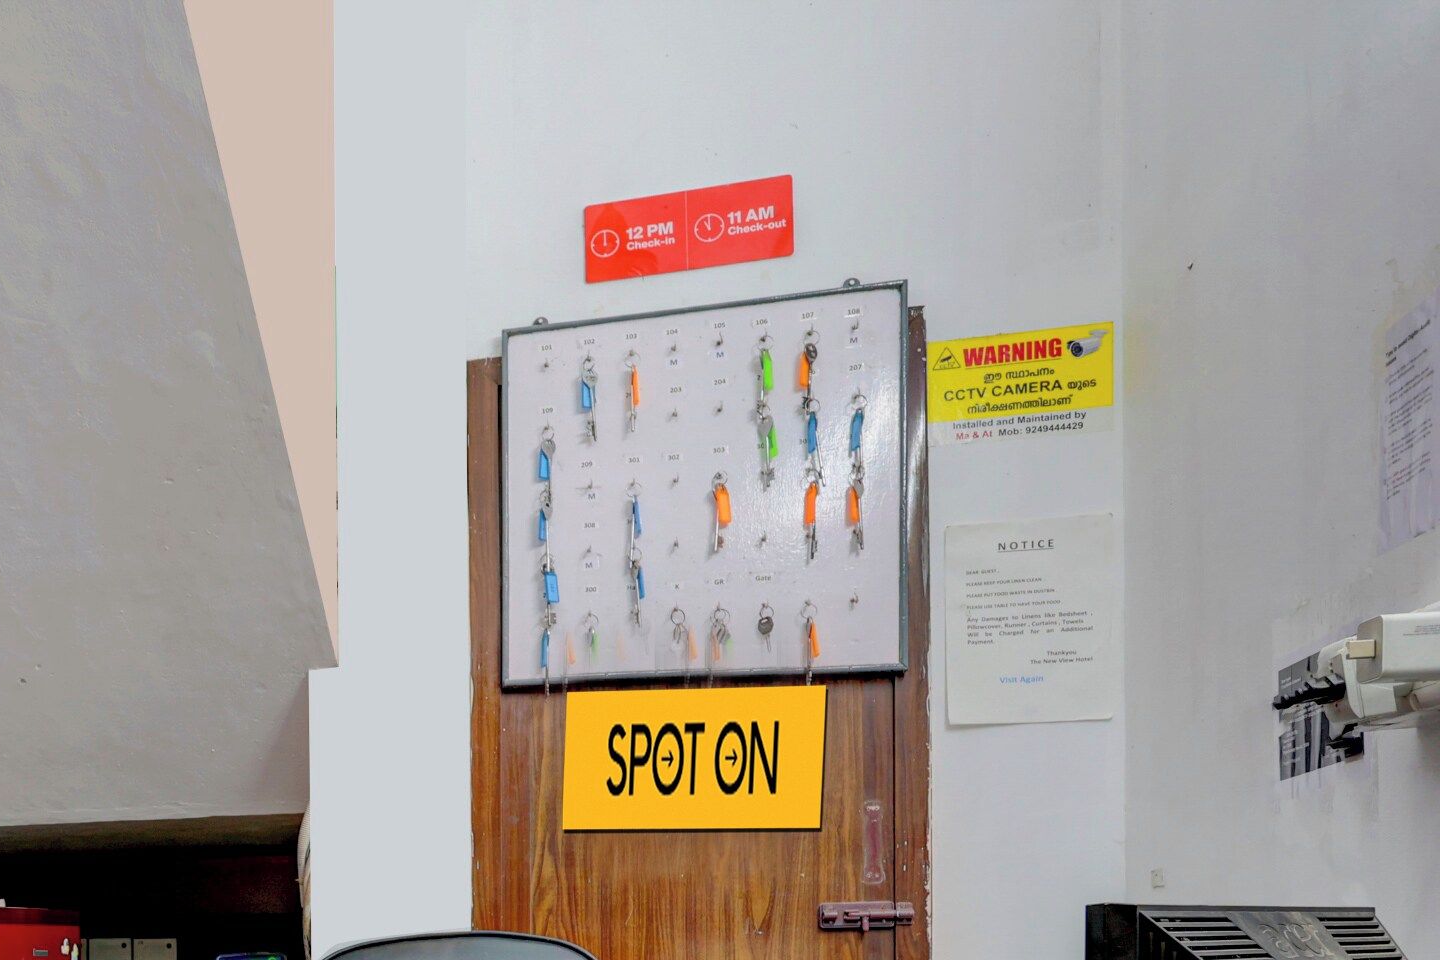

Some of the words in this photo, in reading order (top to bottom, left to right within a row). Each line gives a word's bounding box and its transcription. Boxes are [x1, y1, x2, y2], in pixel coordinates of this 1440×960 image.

[727, 211, 742, 225] 11
[745, 205, 775, 221] AM
[626, 226, 644, 240] 12
[647, 221, 674, 237] PM
[728, 218, 787, 236] Check-out
[626, 235, 676, 251] Check-in
[802, 312, 814, 320] 107
[848, 308, 861, 316] 108
[713, 322, 726, 330] 105
[755, 318, 768, 326] 106
[666, 328, 679, 336] 104
[963, 338, 1063, 367] WARNING
[849, 364, 862, 372] 207
[713, 378, 726, 386] 204
[944, 387, 986, 401] CCTV
[991, 379, 1063, 397] CAMERA
[953, 419, 994, 430] Installed
[996, 416, 1015, 427] and
[1017, 411, 1072, 425] Maintained
[1074, 410, 1087, 421] by
[998, 427, 1023, 437] Mob:
[1025, 422, 1084, 435] 9249444429
[581, 461, 593, 469] 209
[998, 538, 1055, 551] NOTICE
[1000, 676, 1017, 684] Visit
[1020, 675, 1044, 684] Again
[606, 722, 706, 797] SPOT
[714, 720, 780, 795] ON
